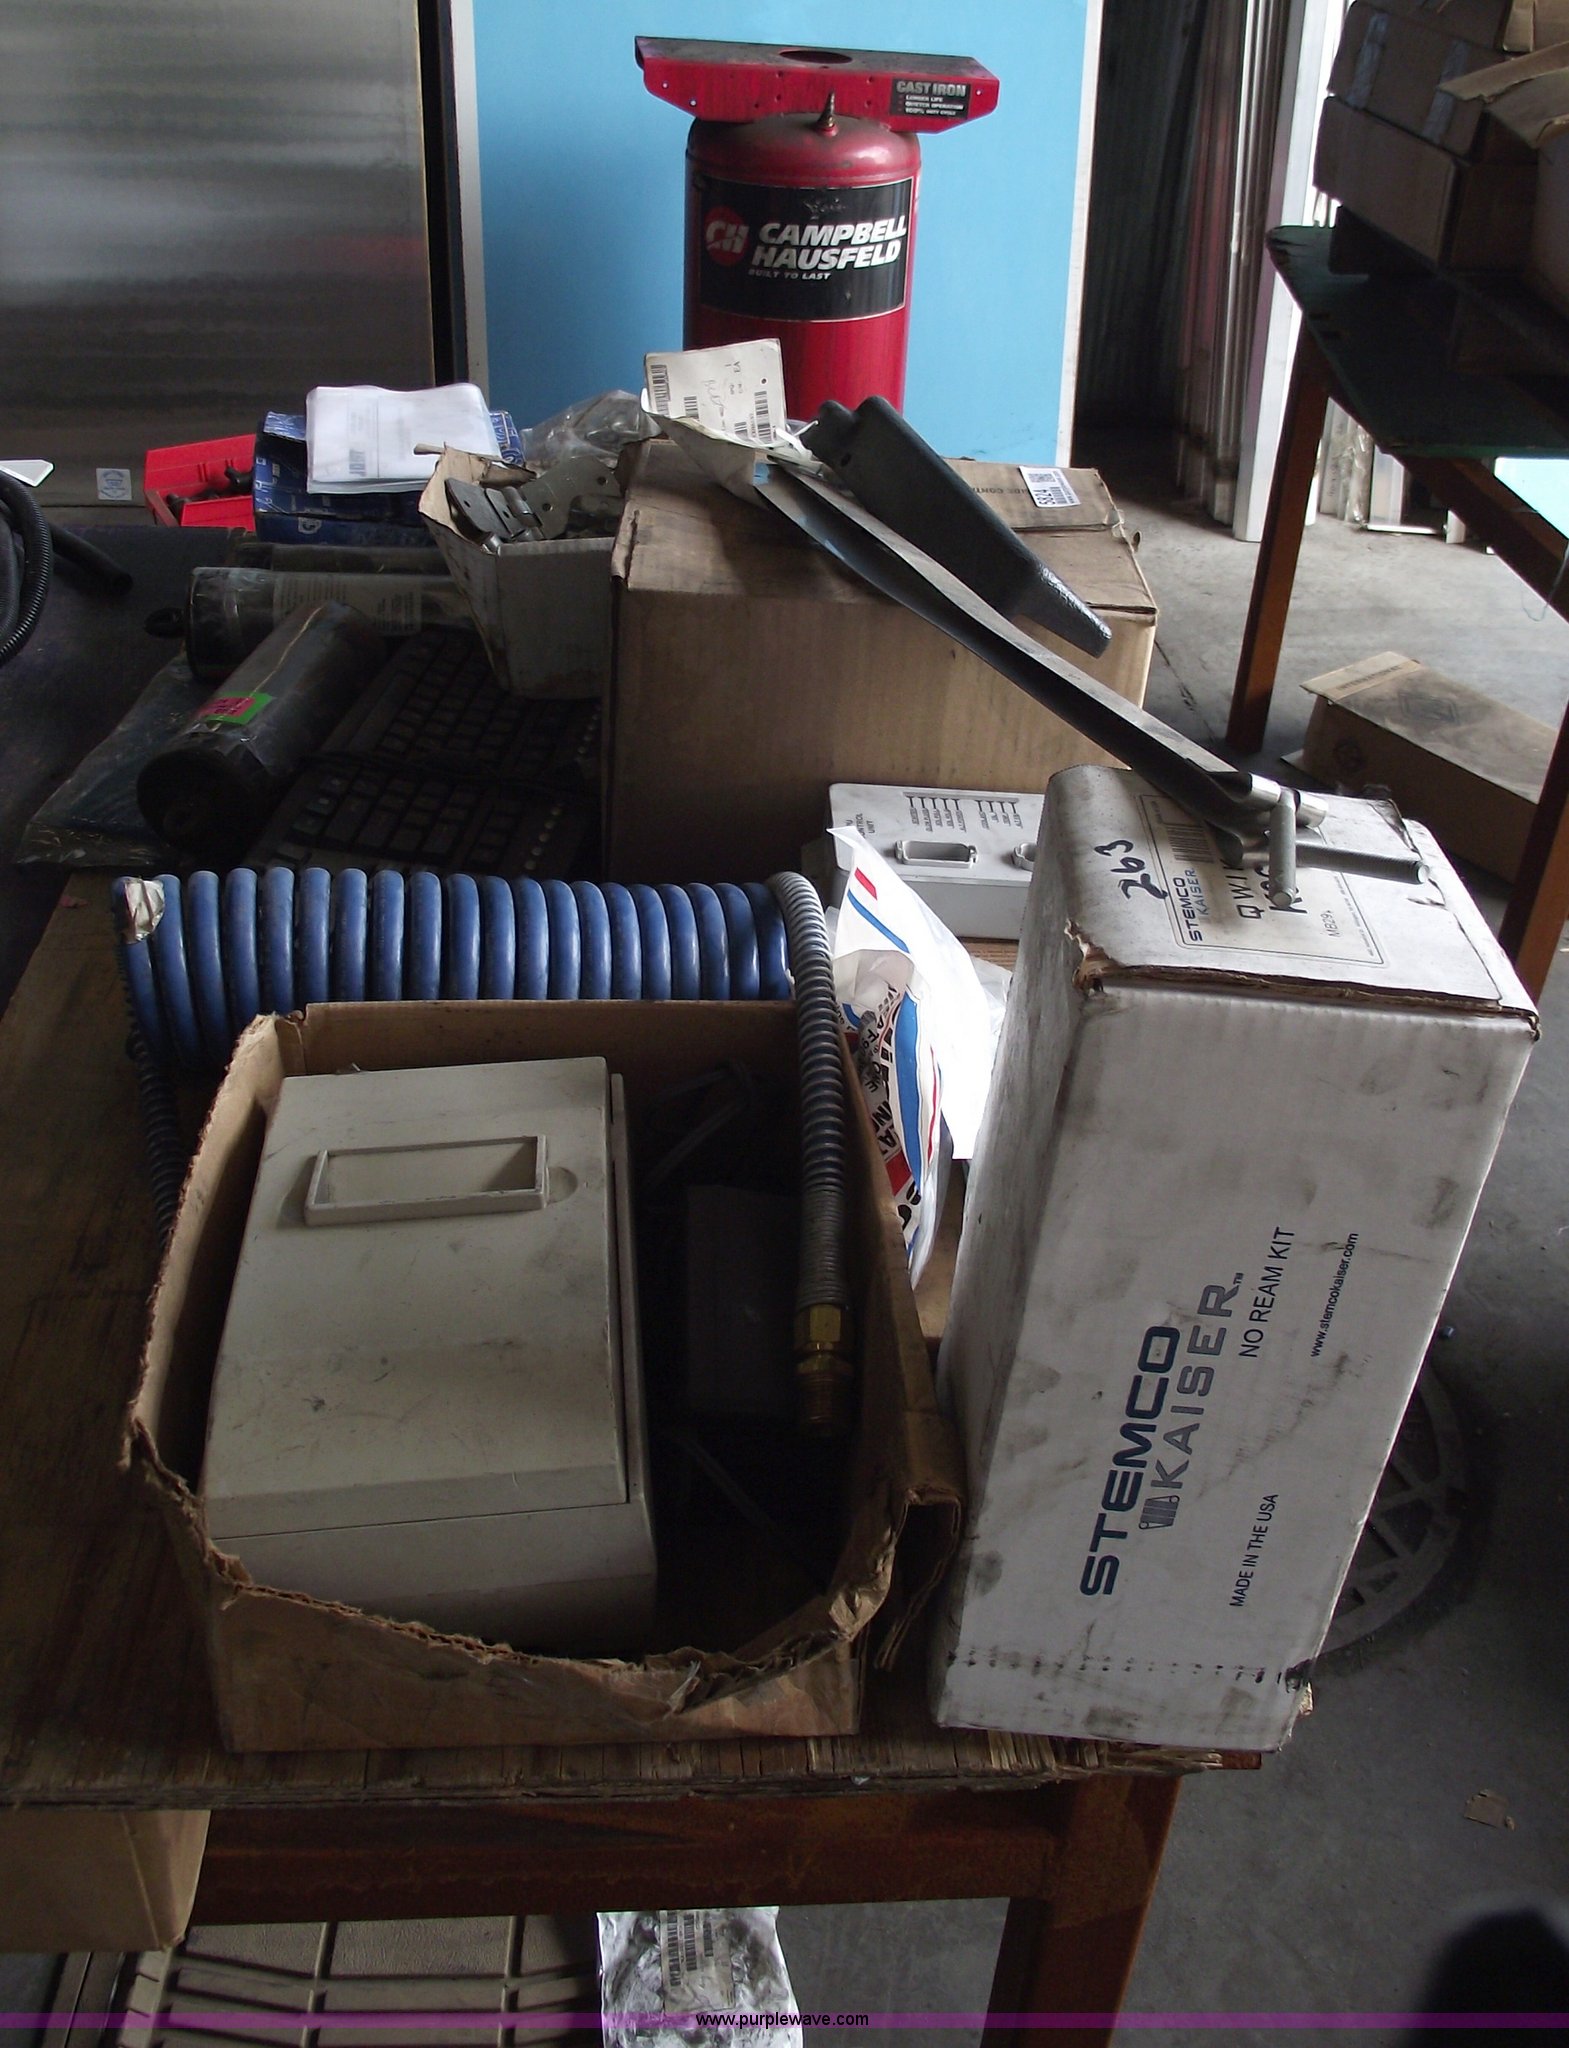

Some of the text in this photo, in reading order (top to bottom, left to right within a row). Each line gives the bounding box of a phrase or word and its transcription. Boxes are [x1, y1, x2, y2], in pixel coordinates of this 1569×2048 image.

[896, 80, 967, 97] CAST IRON
[751, 239, 901, 271] HAUSFELD
[758, 215, 907, 247] CAMPBELL
[748, 268, 832, 281] BUILT TO LAST
[1094, 839, 1168, 899] 263
[1184, 869, 1209, 916] KAISER
[1173, 877, 1203, 941] STEMCO
[1238, 1226, 1295, 1358] NO REAM KIT
[1310, 1232, 1359, 1357] www.stemcokaiser.com
[1150, 1284, 1239, 1489] KAISER
[1080, 1326, 1180, 1595] STEMCO
[1229, 1494, 1279, 1606] MADE IN THE USA
